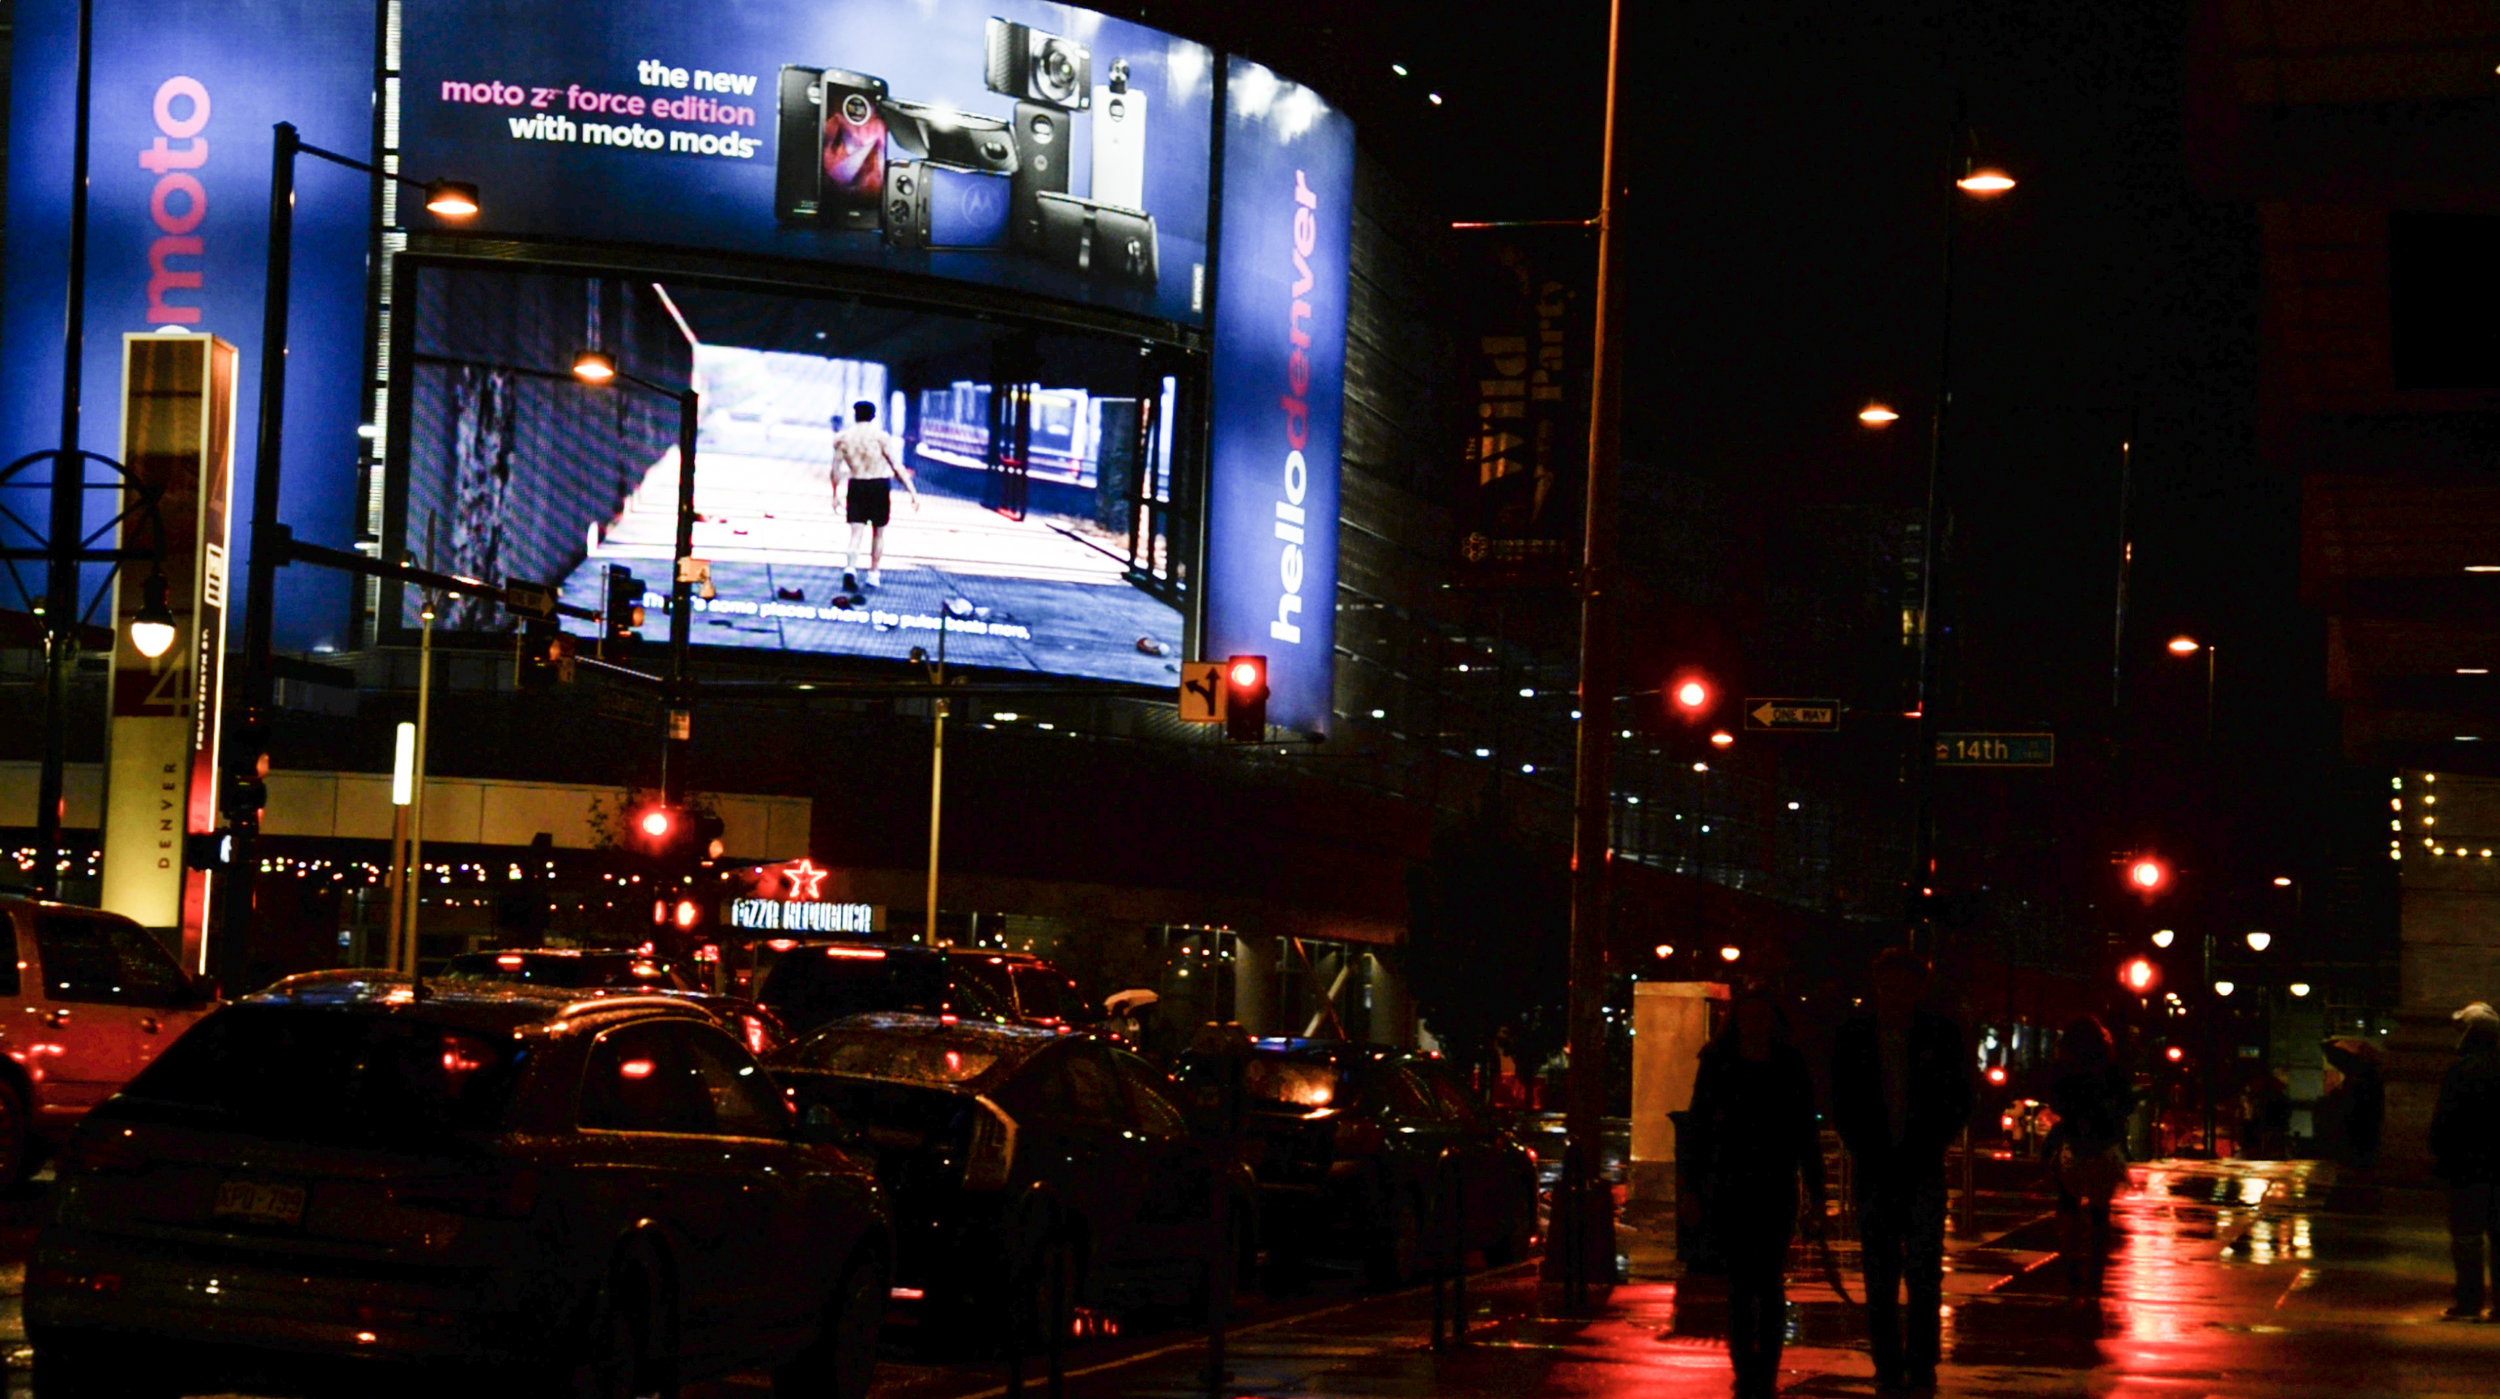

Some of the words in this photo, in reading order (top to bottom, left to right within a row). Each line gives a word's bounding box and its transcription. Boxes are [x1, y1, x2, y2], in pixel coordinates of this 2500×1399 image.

[638, 60, 690, 88] the
[693, 70, 757, 96] new
[441, 80, 525, 107] moto
[567, 84, 647, 116] force
[652, 96, 756, 127] edition
[509, 113, 577, 142] with
[582, 123, 665, 150] moto
[1530, 280, 1577, 401] Party
[1477, 335, 1527, 486] Wild
[708, 600, 758, 615] some
[759, 602, 817, 618] places
[818, 606, 870, 623] where
[871, 610, 899, 626] the
[900, 613, 942, 630] pulse
[1773, 708, 1797, 721] ONE
[1802, 709, 1828, 722] WAY
[1955, 739, 2009, 760] 14th
[158, 763, 177, 869] DENVER
